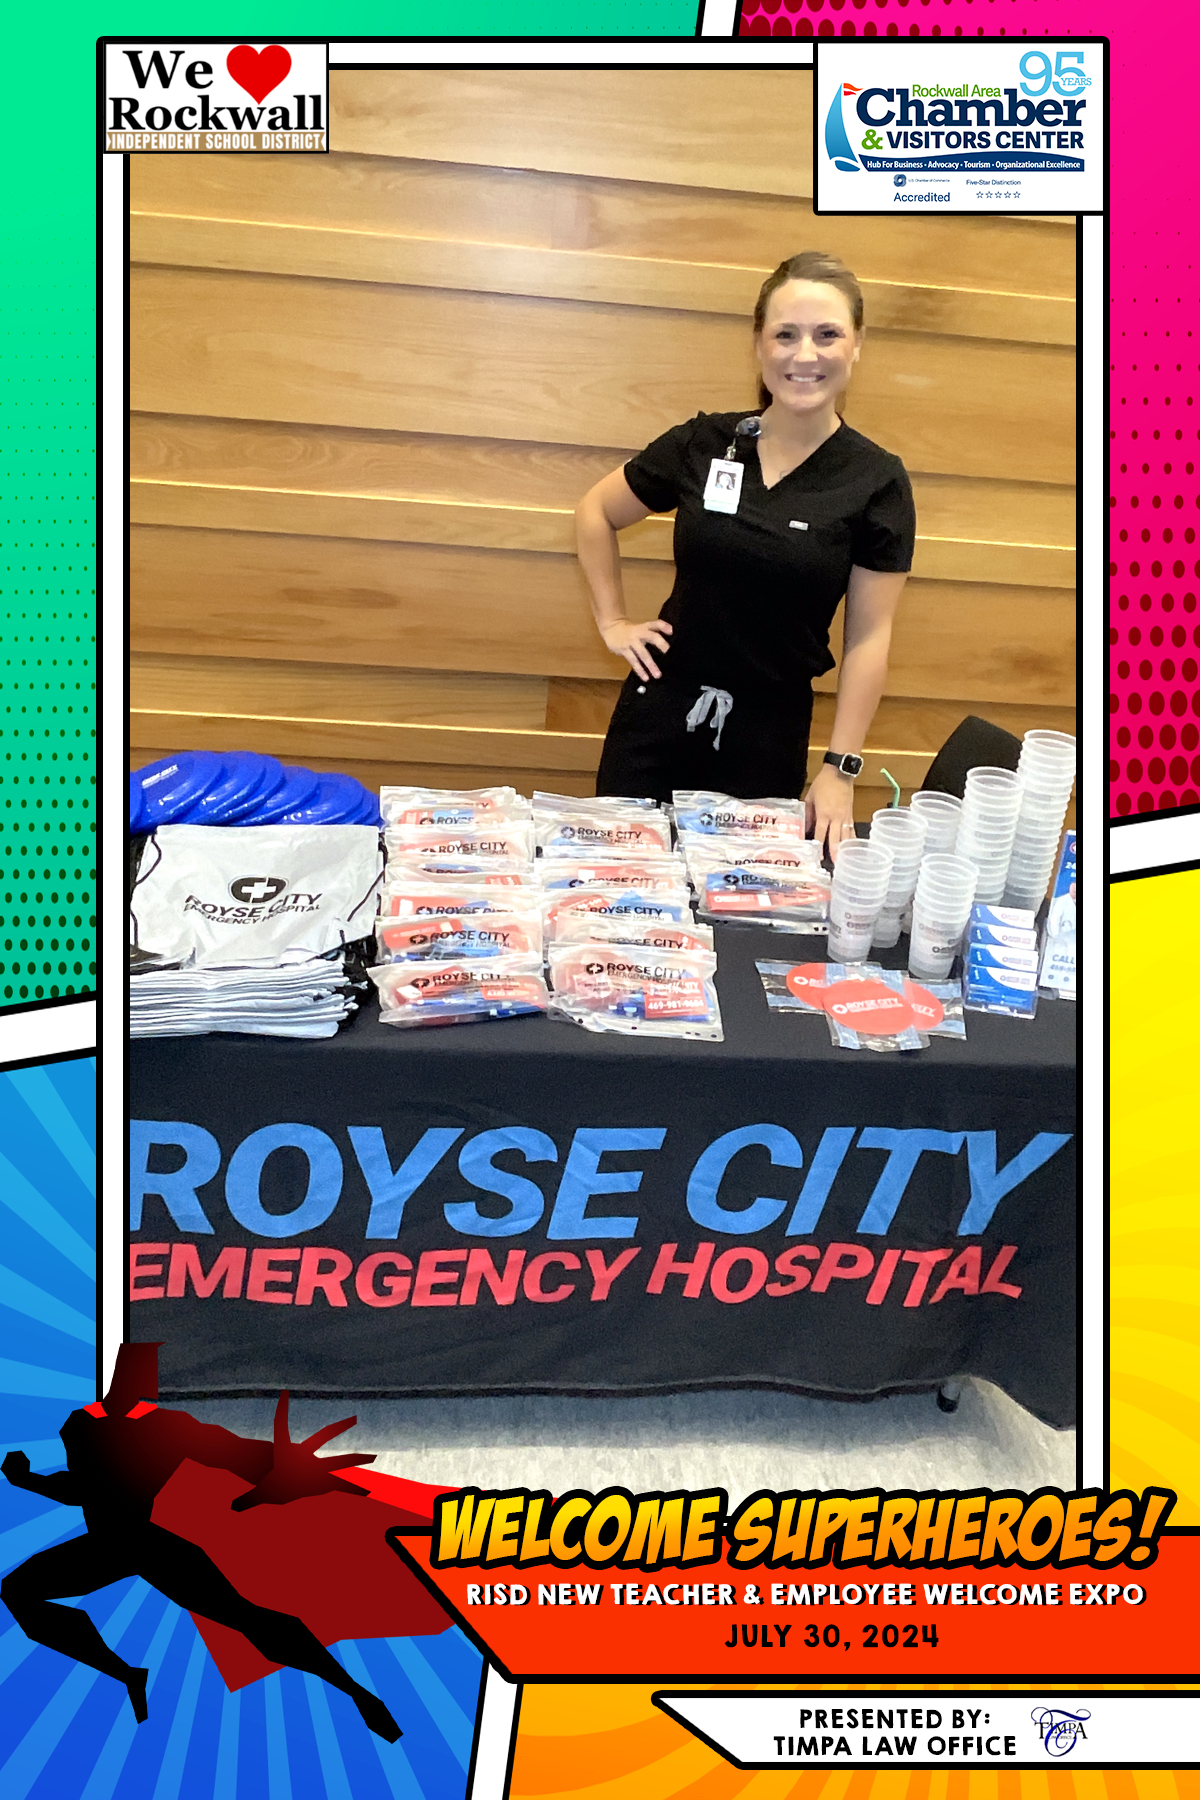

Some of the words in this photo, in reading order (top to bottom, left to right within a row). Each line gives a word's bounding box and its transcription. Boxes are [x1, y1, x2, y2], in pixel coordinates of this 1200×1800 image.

[753, 814, 778, 824] CITY
[577, 827, 613, 838] ROYSE
[616, 830, 641, 839] CITY
[438, 843, 478, 853] ROYSE
[480, 842, 507, 850] CITY
[185, 894, 266, 918] ROYSE
[268, 894, 323, 913] CITY
[634, 907, 663, 916] CITY
[184, 904, 261, 925] EMERGENCY
[430, 930, 476, 942] ROYSE
[478, 931, 510, 943] CITY
[653, 938, 683, 949] CITY
[432, 972, 478, 981] ROYSE
[607, 963, 651, 974] ROYSE
[654, 967, 685, 979] CITY
[878, 998, 899, 1008] CITY
[130, 1119, 667, 1240] ROYSE
[686, 1123, 1074, 1237] CITY
[130, 1243, 641, 1307] EMERGENCY
[646, 1242, 1022, 1308] HOSPITAL
